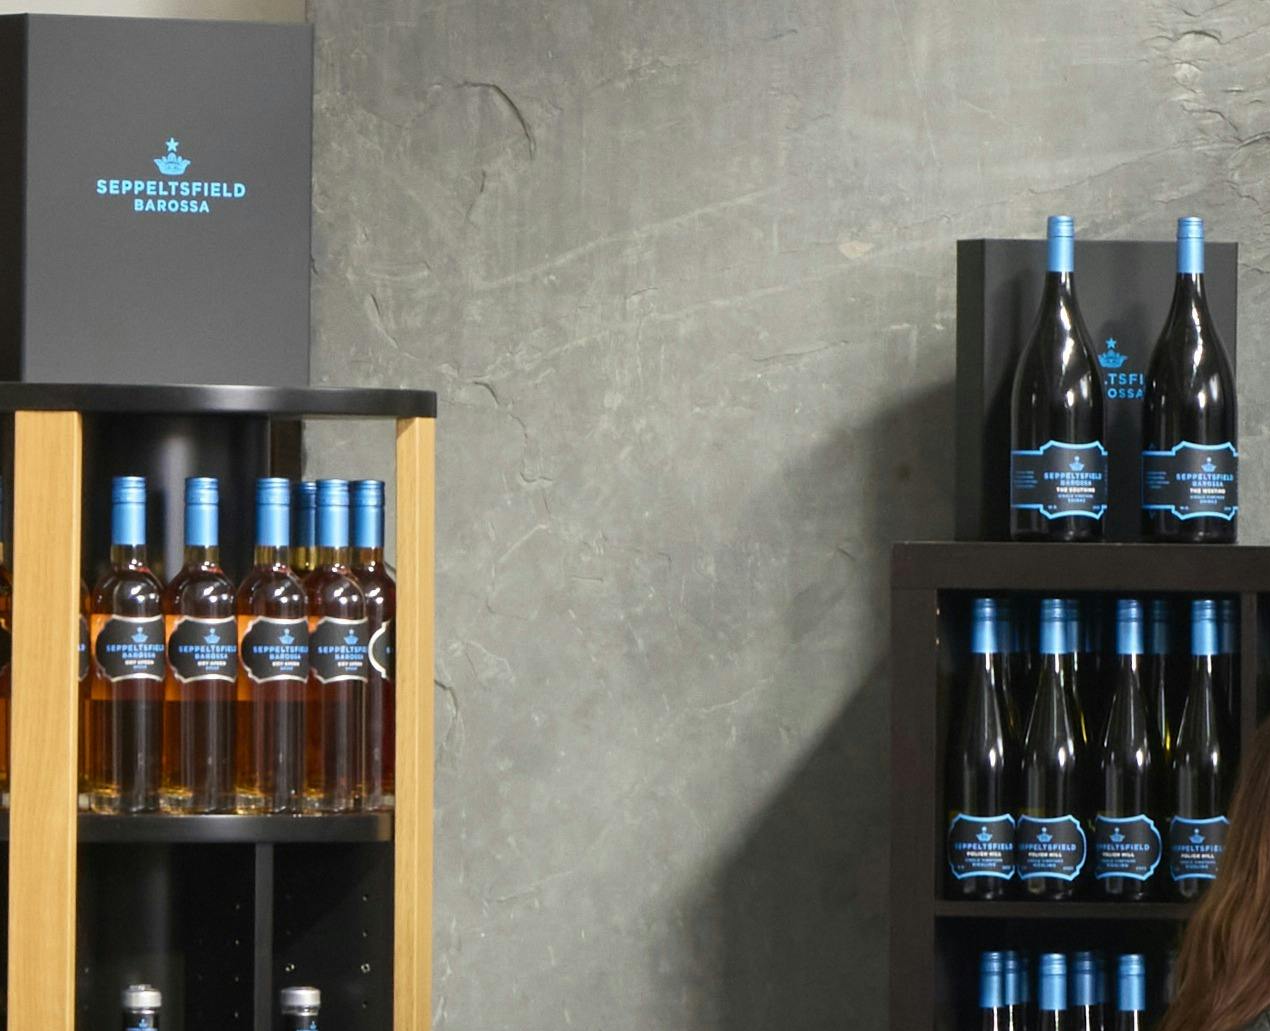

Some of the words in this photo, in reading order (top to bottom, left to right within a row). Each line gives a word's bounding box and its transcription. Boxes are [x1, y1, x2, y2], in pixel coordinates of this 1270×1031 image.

[96, 179, 247, 198] SEPPELTSFIELD
[134, 198, 210, 213] BAROSSA
[1107, 388, 1144, 399] OSSA
